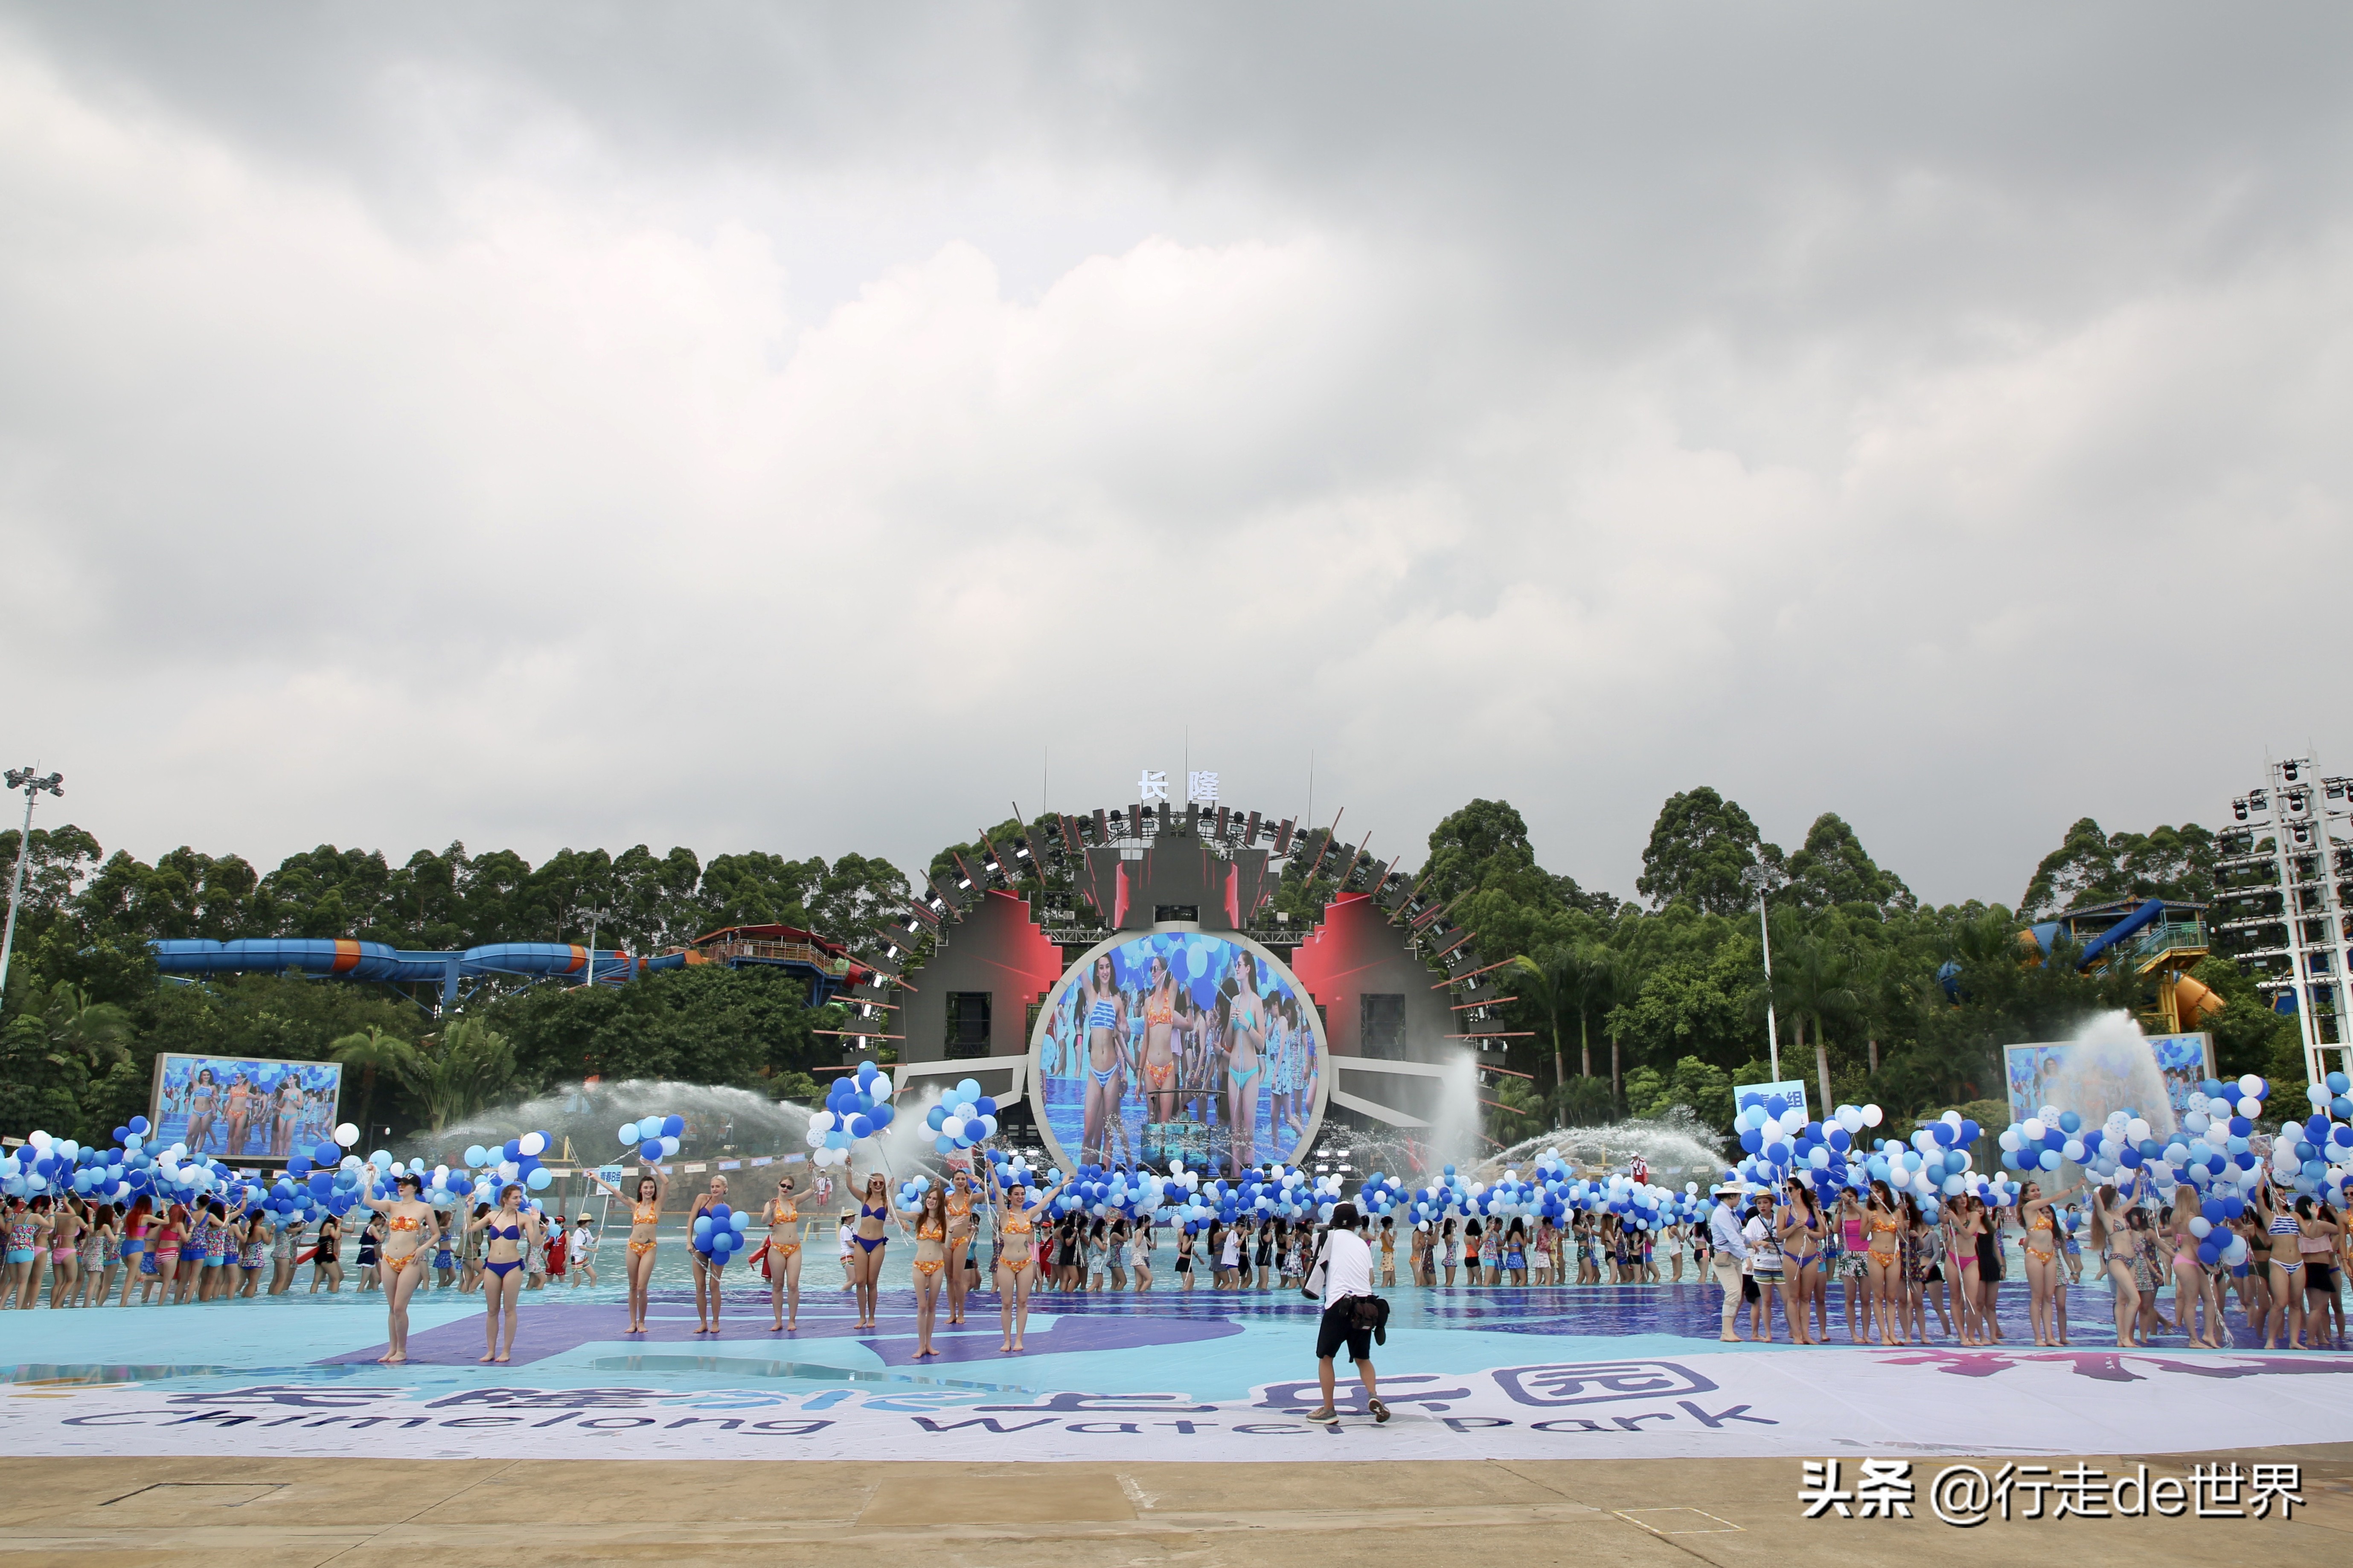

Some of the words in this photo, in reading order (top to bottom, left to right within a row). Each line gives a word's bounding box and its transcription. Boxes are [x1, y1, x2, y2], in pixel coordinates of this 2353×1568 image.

[1137, 769, 1219, 801] 长隆
[600, 1171, 621, 1182] 青春B组
[61, 1410, 836, 1435] Chimelong
[910, 1416, 1387, 1434] Water
